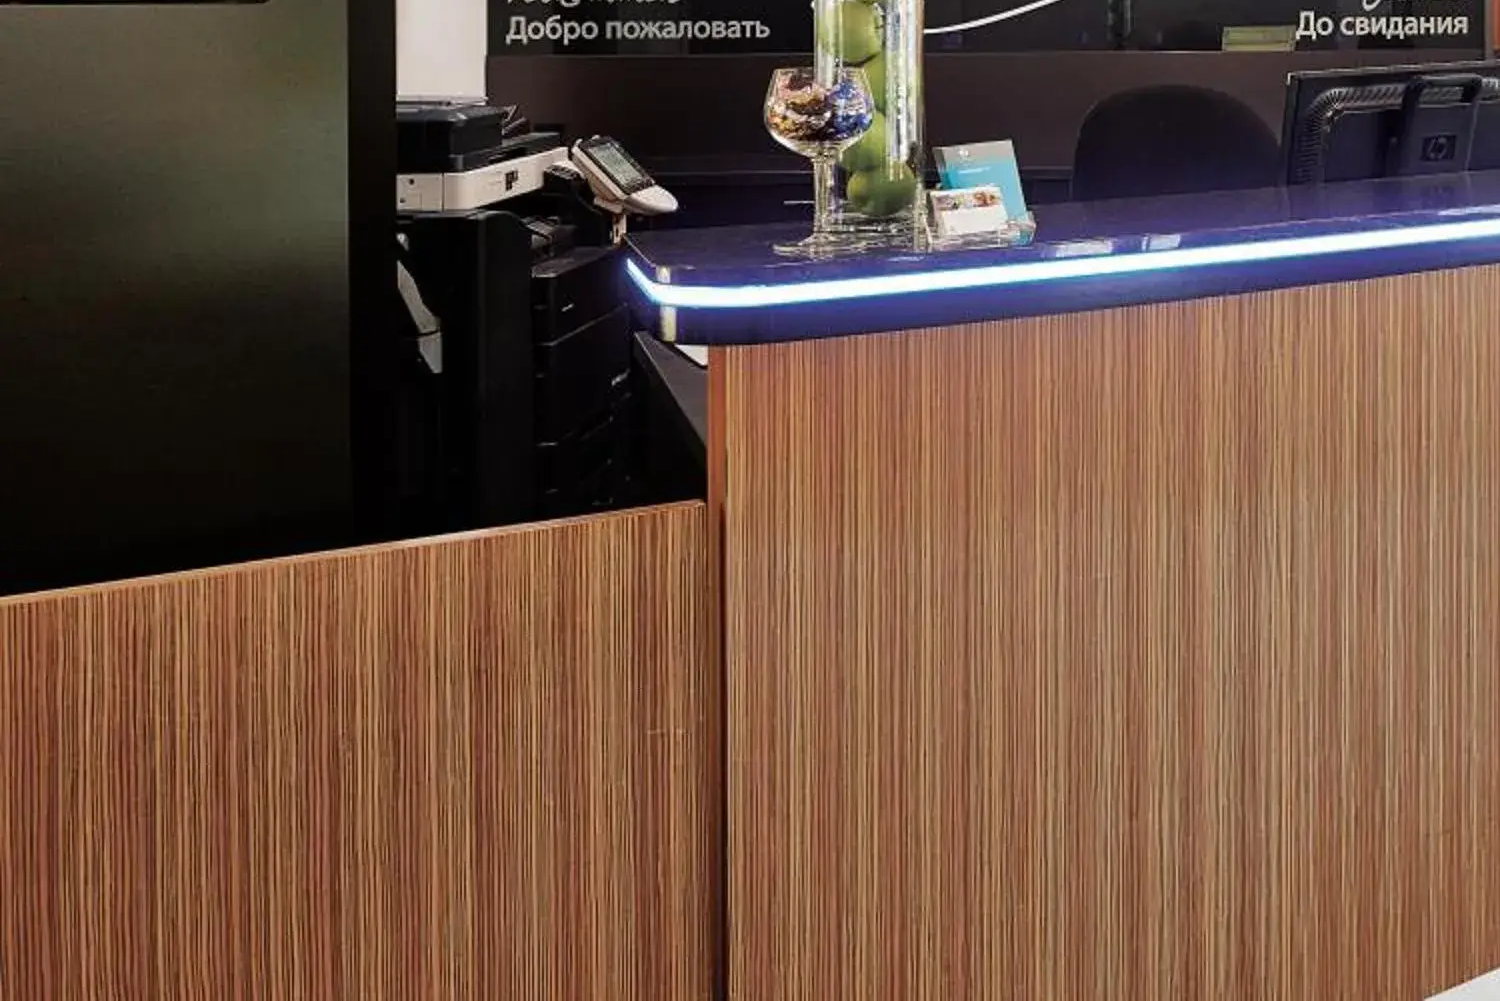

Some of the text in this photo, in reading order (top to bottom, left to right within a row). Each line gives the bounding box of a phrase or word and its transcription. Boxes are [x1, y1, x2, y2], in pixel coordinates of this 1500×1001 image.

[505, 14, 770, 45] Добро пожаловать
[1296, 11, 1468, 40] До свидания
